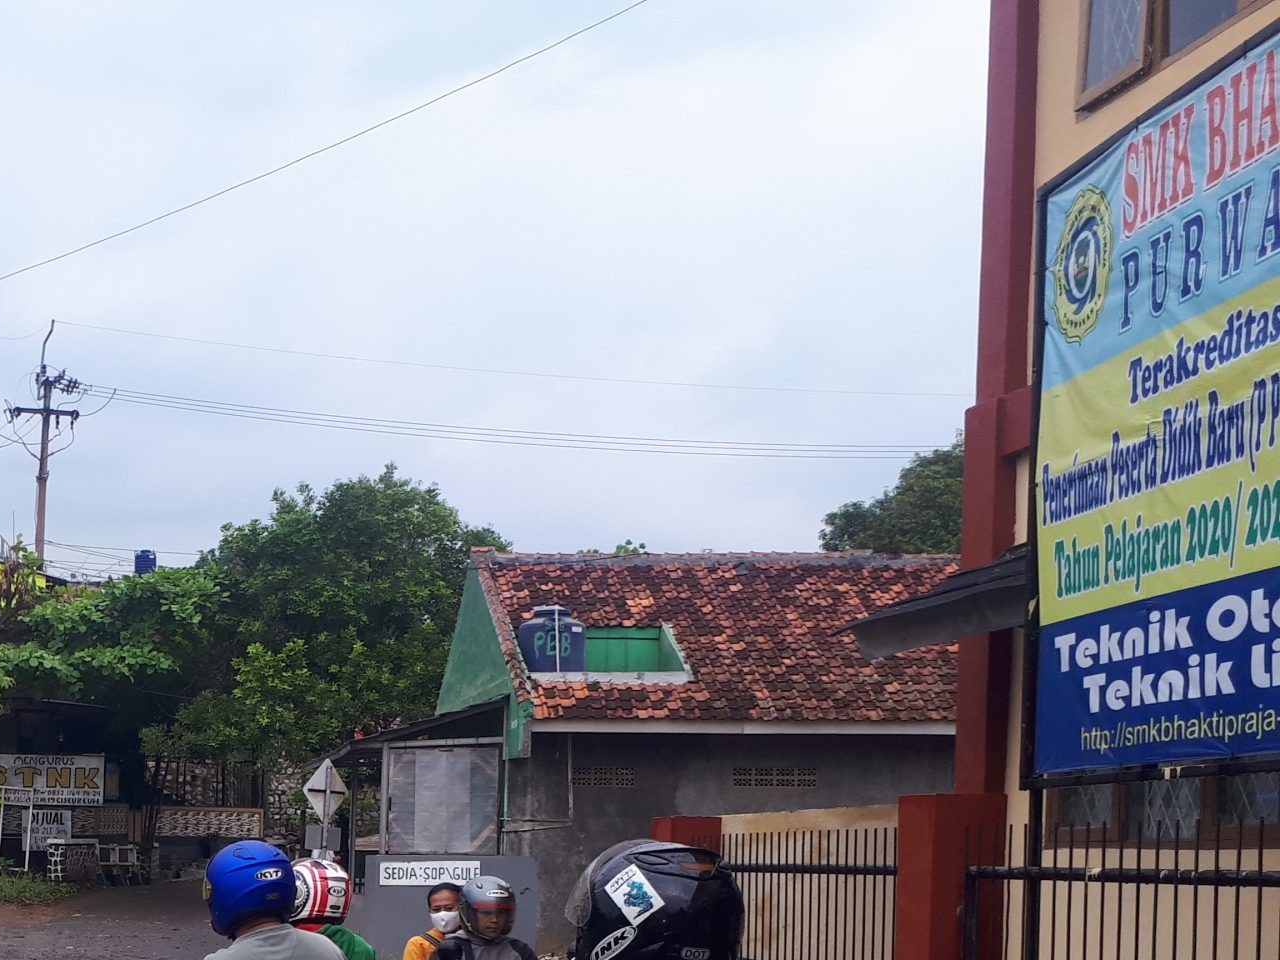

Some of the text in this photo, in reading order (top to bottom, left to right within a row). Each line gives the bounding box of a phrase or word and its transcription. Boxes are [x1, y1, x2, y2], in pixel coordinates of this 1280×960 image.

[1122, 103, 1195, 236] SMK
[1042, 452, 1108, 527] Penerimaan
[1109, 430, 1158, 502] Peserta
[1161, 399, 1202, 484] Didik
[1206, 390, 1245, 469] Baru
[1054, 538, 1100, 599] Tahun
[1103, 514, 1182, 592] Pelajaran
[1054, 608, 1193, 672] Teknik
[1083, 653, 1236, 713] Teknik
[13, 756, 76, 766] MENGURUS
[684, 948, 708, 960] DOT
